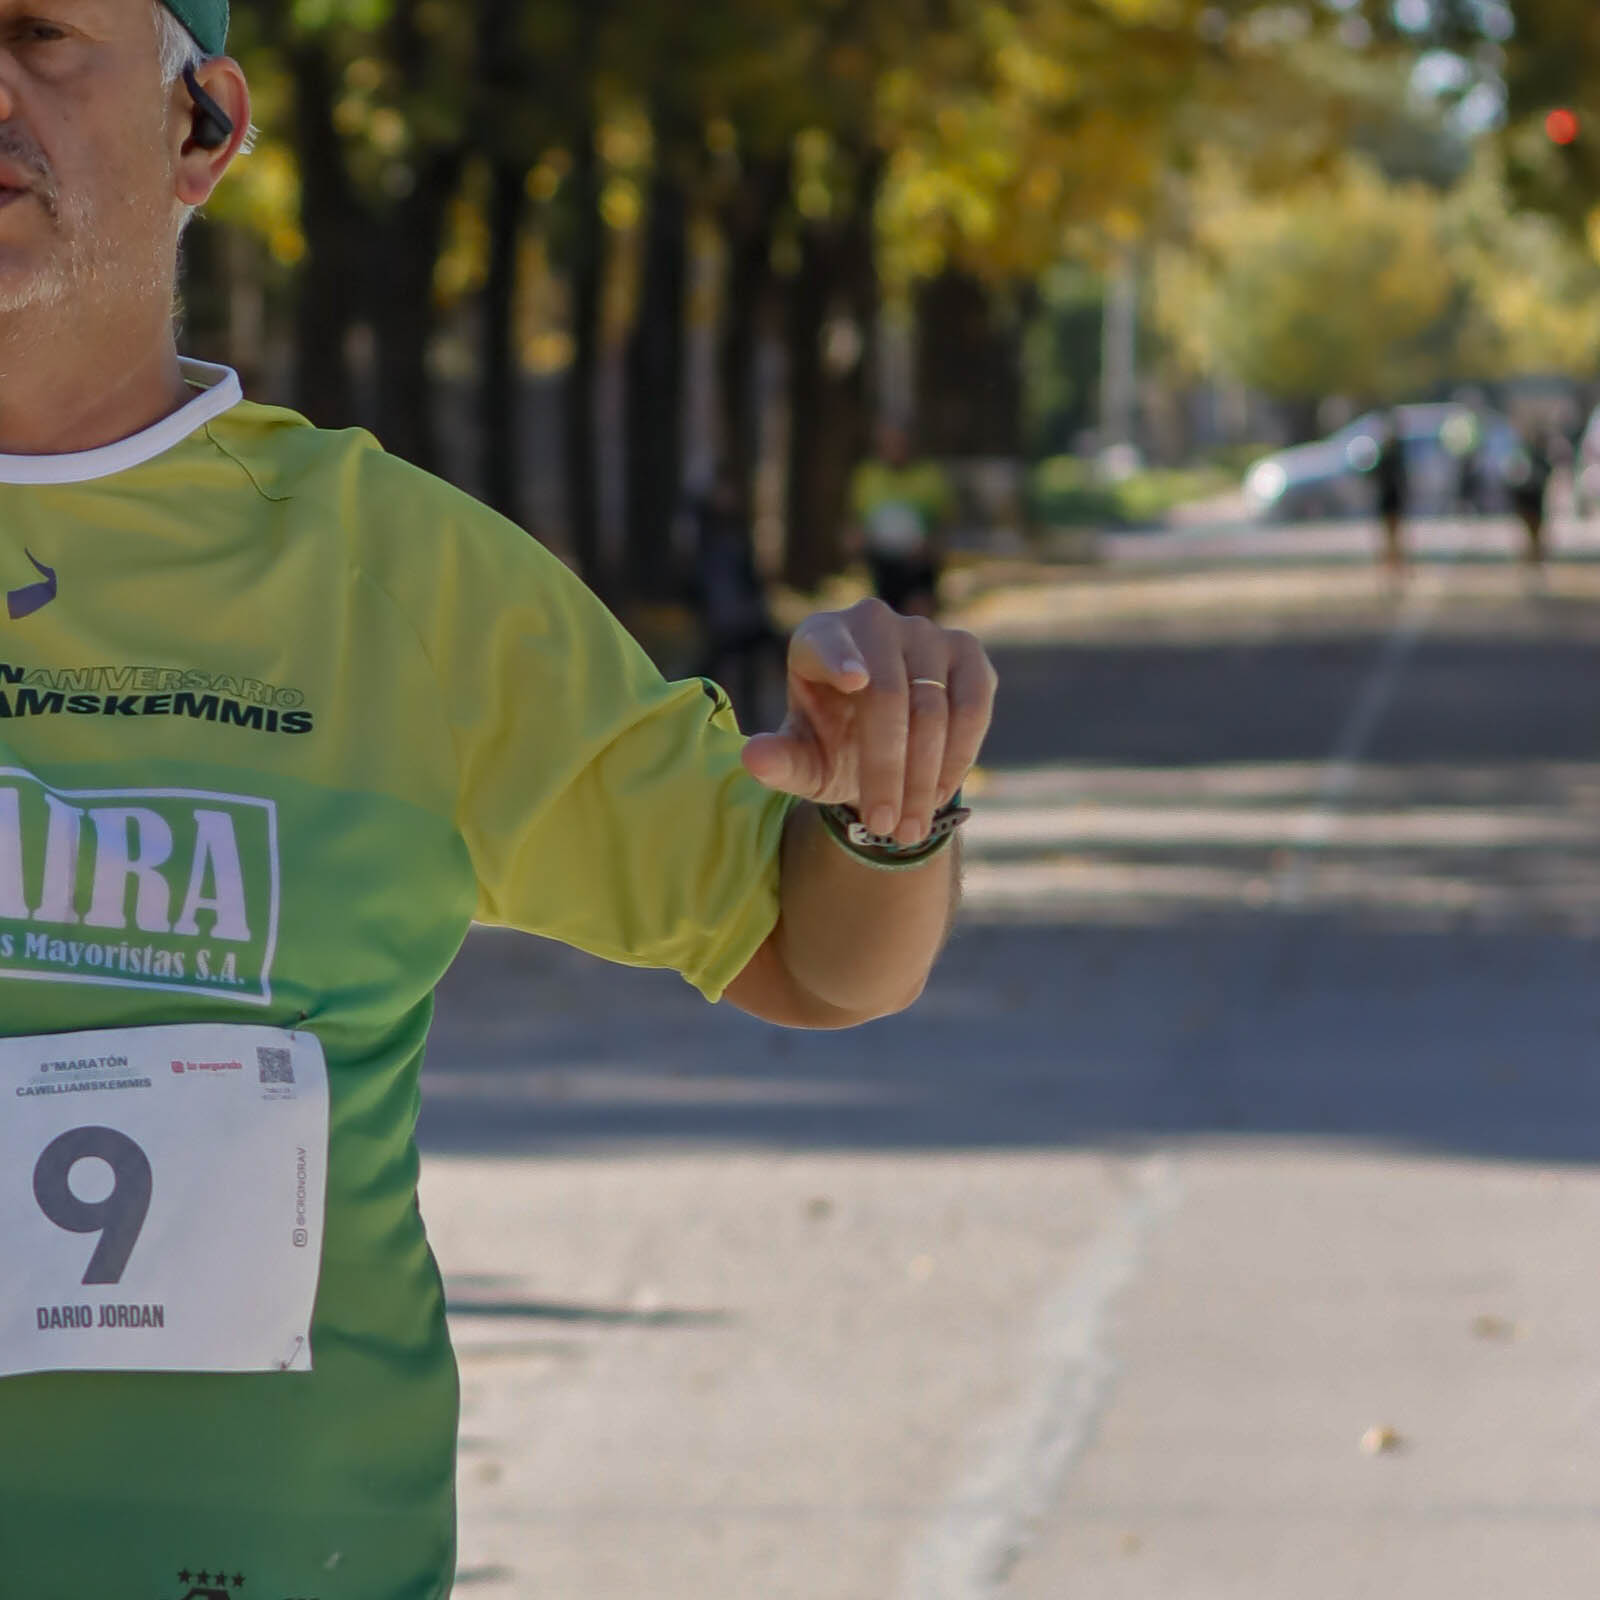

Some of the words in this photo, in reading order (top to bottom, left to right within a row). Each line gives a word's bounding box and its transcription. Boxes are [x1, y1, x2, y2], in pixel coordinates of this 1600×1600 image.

[24, 665, 305, 708] ANIVERSARIO
[23, 931, 186, 980] Mayoristas
[195, 949, 245, 985] S.A.
[32, 1125, 153, 1286] 9
[36, 1304, 94, 1330] DARIO
[96, 1303, 165, 1329] JORDAN
